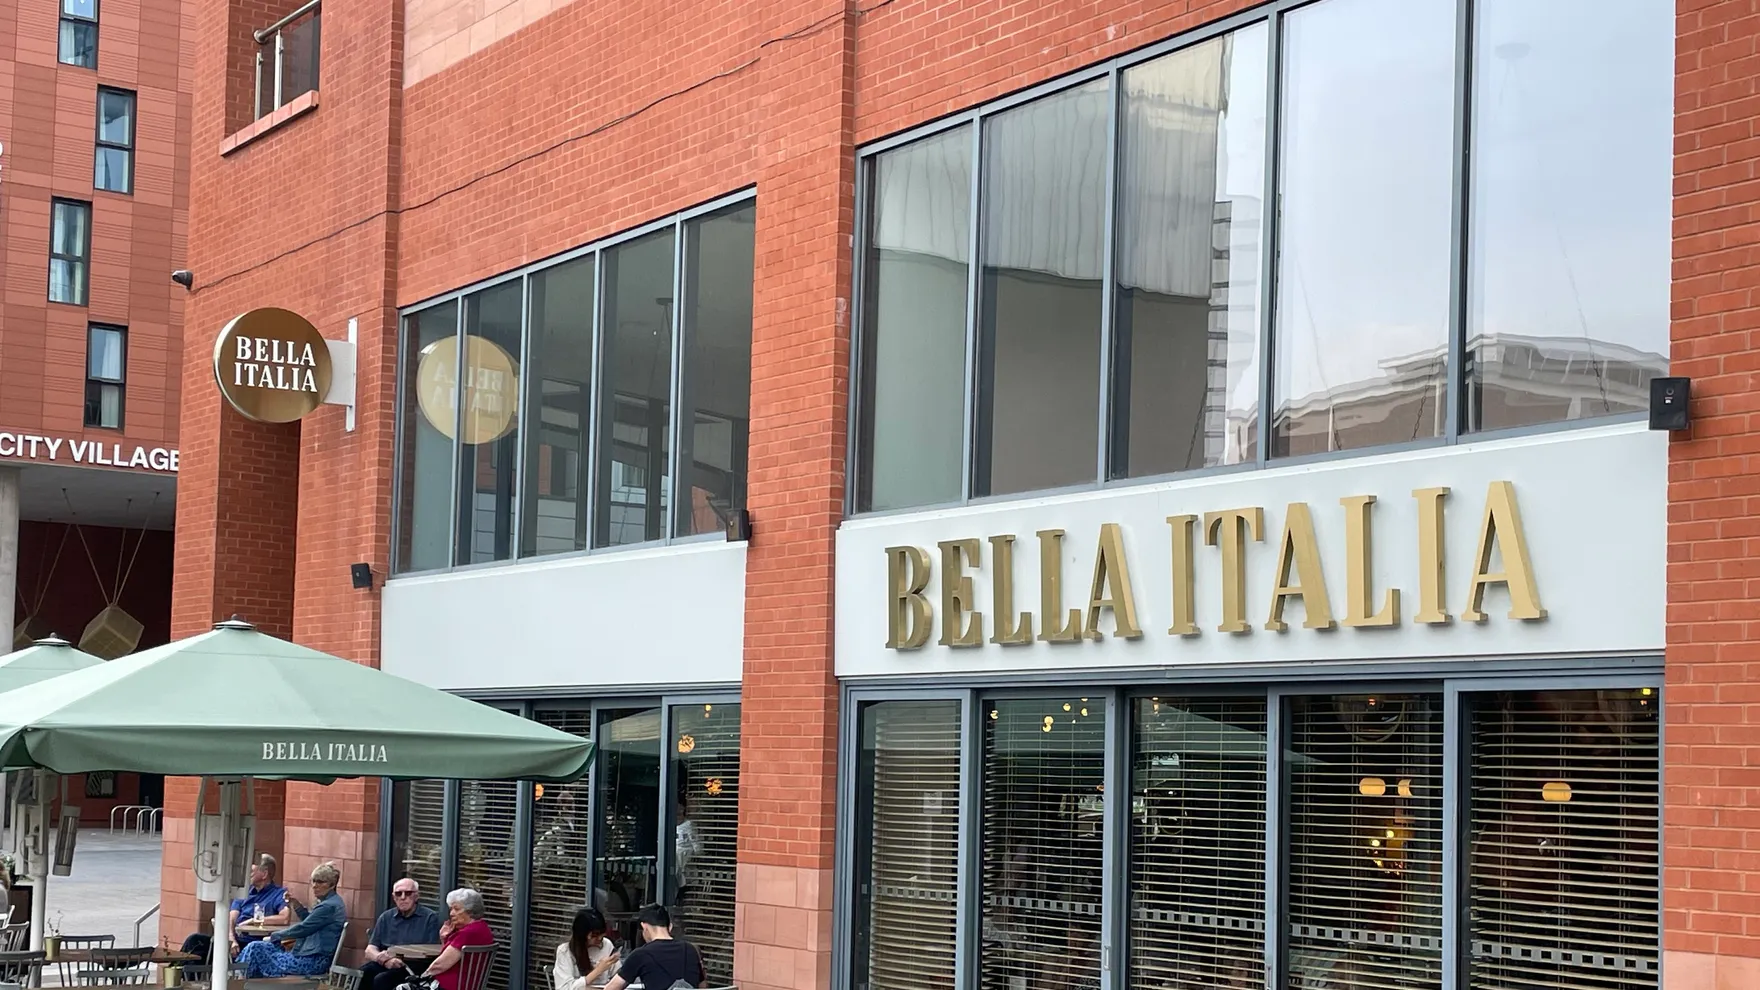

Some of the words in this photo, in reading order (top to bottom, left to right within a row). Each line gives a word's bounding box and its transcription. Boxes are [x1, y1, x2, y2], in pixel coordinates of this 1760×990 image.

[236, 335, 316, 367] BELLA
[234, 362, 318, 393] ITALIA
[0, 432, 62, 460] CITY
[69, 439, 180, 472] VILLAGE
[885, 523, 1143, 650] BELLA
[1166, 480, 1549, 636] ITALIA
[262, 742, 322, 760] BELLA
[328, 743, 388, 762] ITALIA
